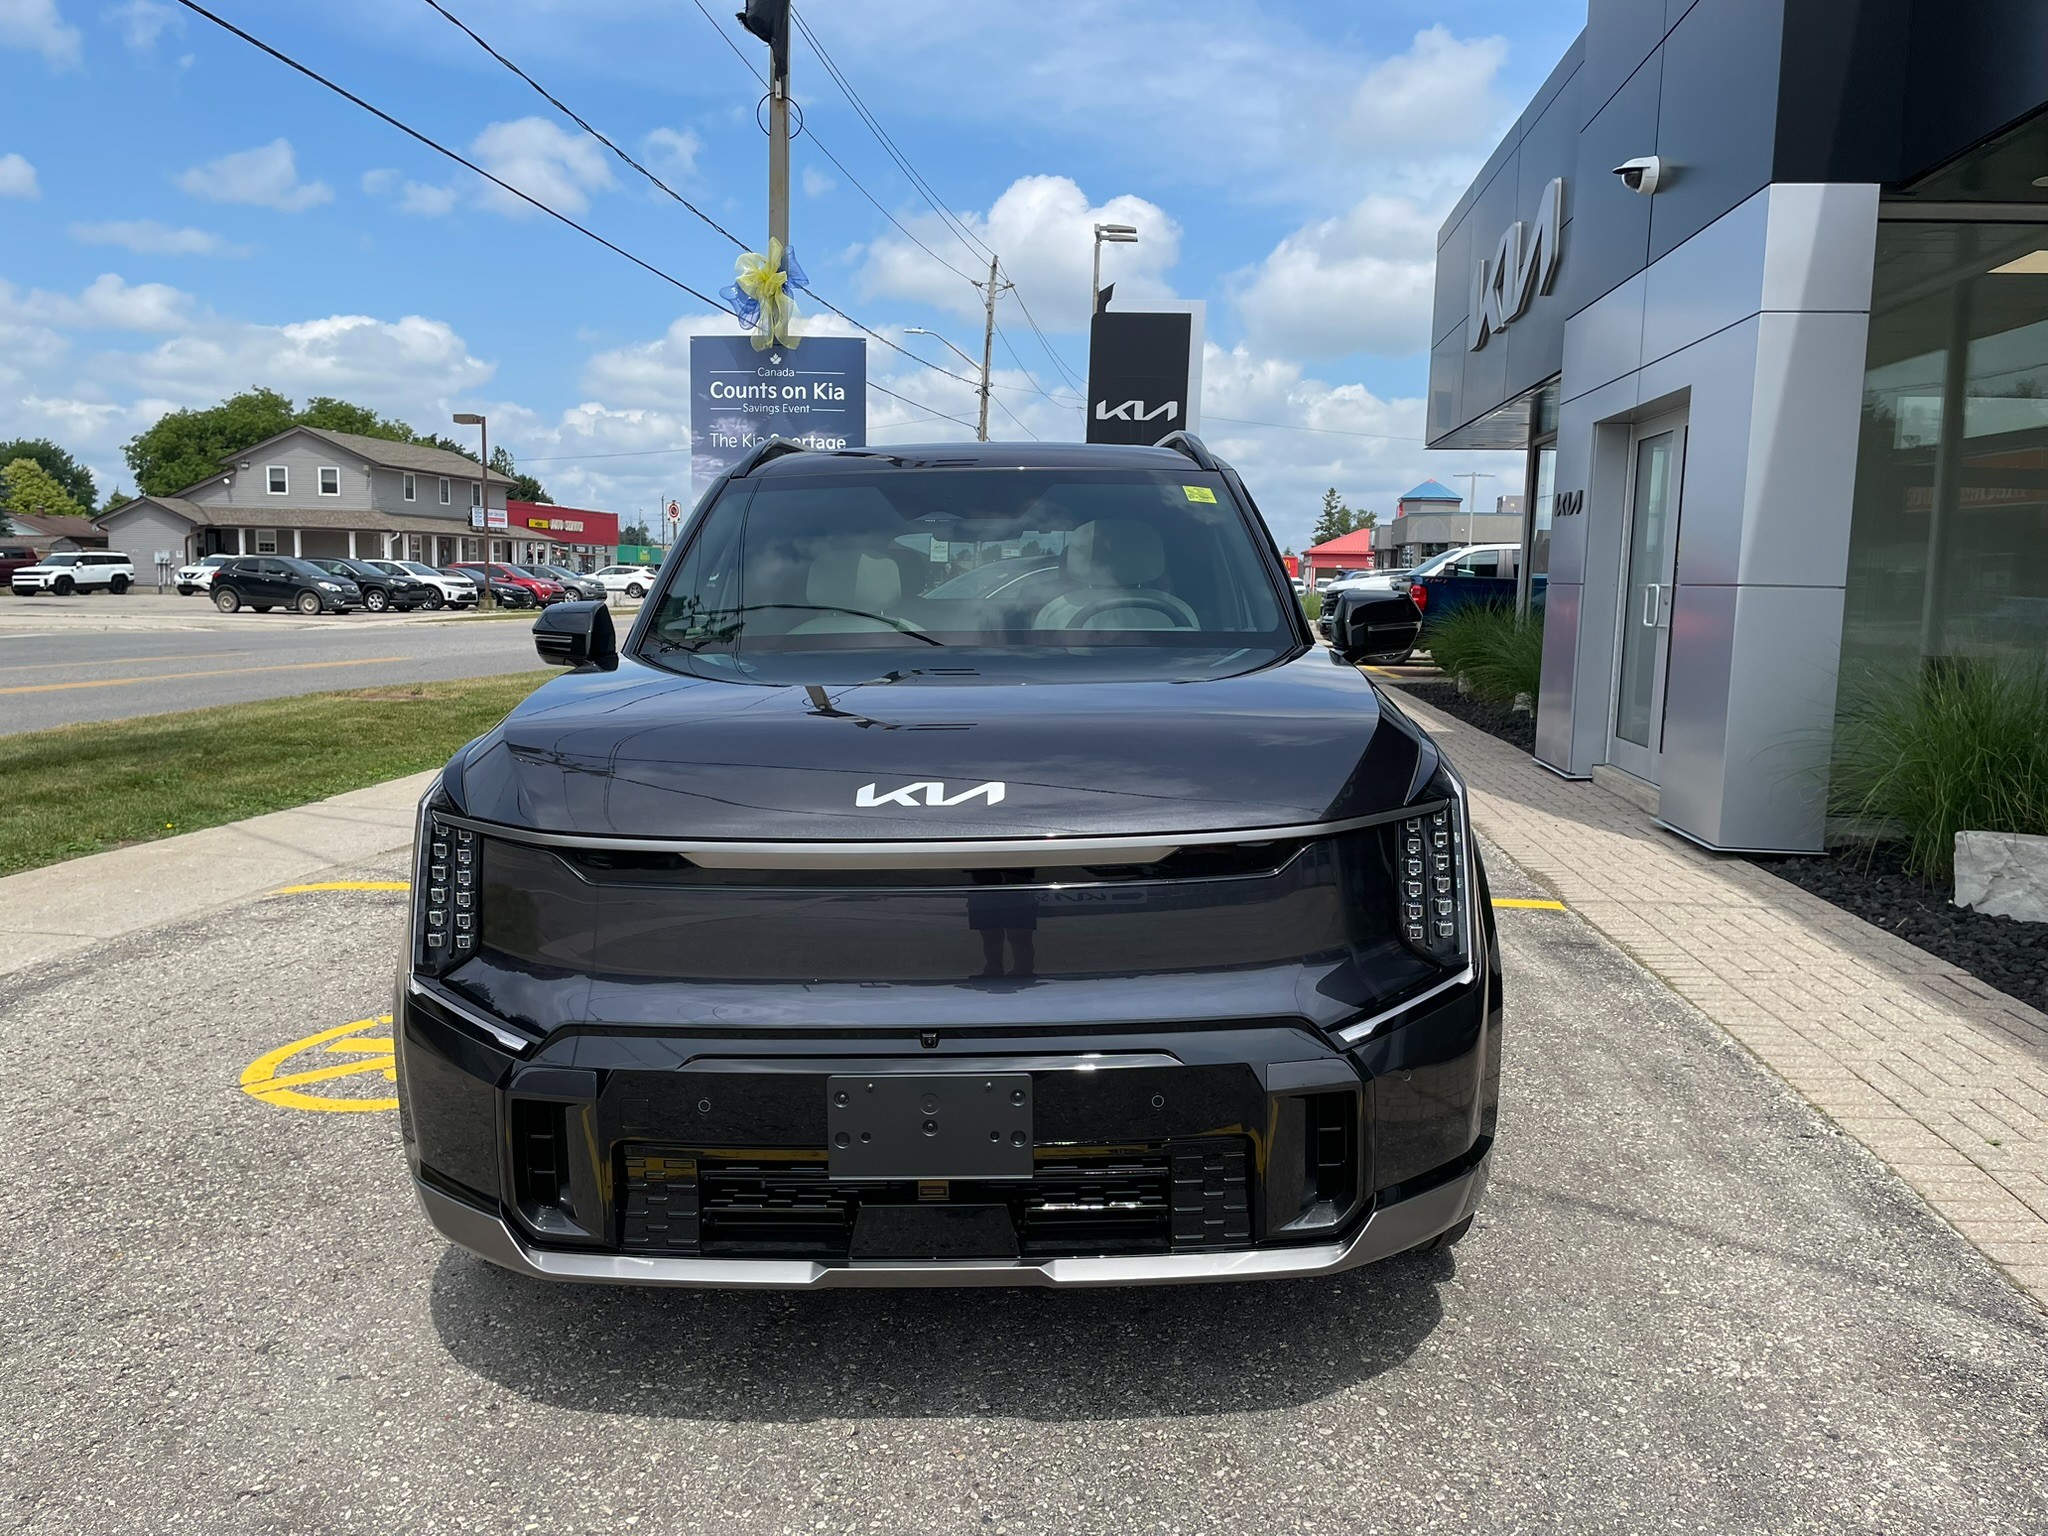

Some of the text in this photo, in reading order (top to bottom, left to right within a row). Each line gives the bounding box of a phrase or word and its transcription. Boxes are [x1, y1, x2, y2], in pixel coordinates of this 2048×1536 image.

[1469, 177, 1563, 352] KIA
[757, 367, 795, 377] Canada
[710, 381, 845, 400] Counts on Kia
[742, 403, 810, 415] Savings Event
[1095, 399, 1178, 421] KIA
[710, 433, 738, 448] The
[1555, 489, 1584, 517] KIA
[855, 781, 1006, 808] KIA
